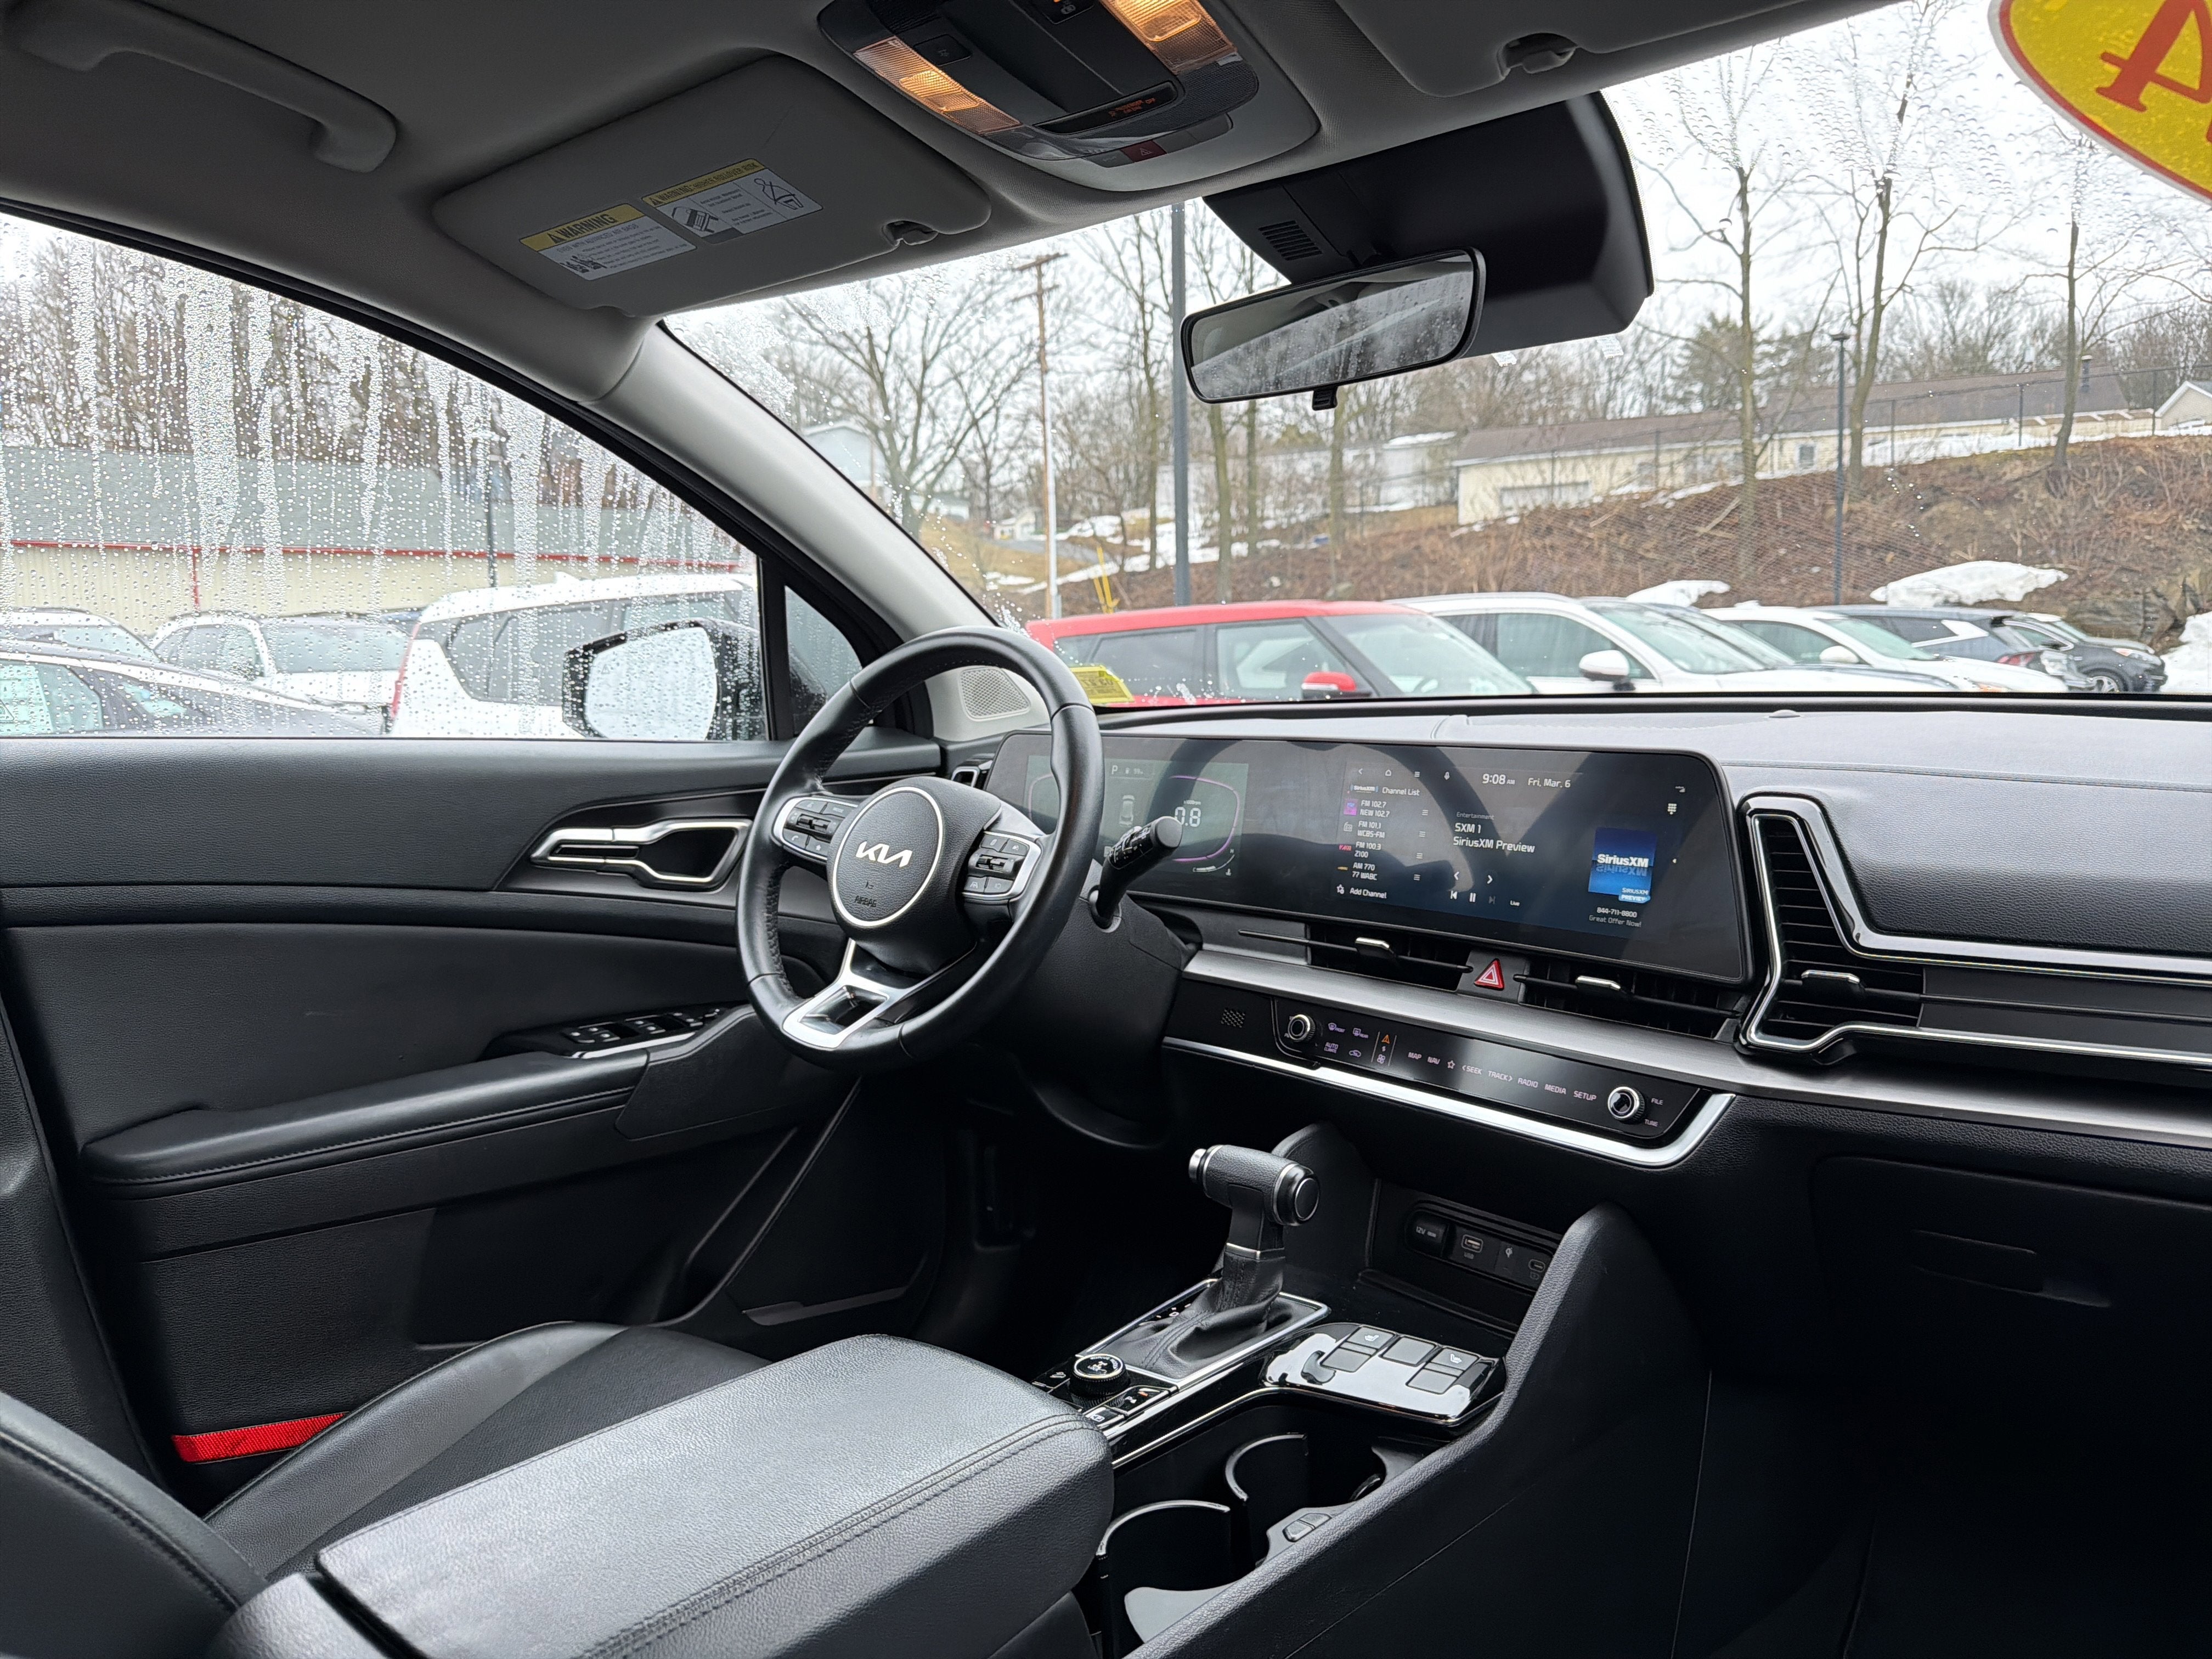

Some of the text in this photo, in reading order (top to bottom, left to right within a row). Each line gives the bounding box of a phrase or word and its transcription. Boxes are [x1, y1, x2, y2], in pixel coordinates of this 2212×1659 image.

[555, 213, 618, 239] WARNING
[1111, 765, 1118, 775] P
[1482, 774, 1506, 785] 9:08
[1543, 778, 1563, 788] Mar.
[1565, 780, 1571, 788] 6
[1382, 787, 1407, 795] Channel
[1175, 806, 1201, 827] 0.8
[1374, 810, 1390, 818] 102.7
[1456, 811, 1495, 820] Entertainment
[1454, 822, 1481, 834] SXM 1
[1453, 836, 1536, 853] SiriusXM Preview
[855, 841, 913, 868] KIA
[1597, 853, 1649, 868] SiriusXM
[1364, 863, 1375, 871] 770
[1360, 872, 1378, 881] WABC
[1349, 887, 1387, 899] Add Channel
[1596, 907, 1638, 918] 844-711-8800
[1607, 917, 1625, 925] Offer
[1626, 919, 1642, 928] Now!
[1408, 1052, 1422, 1060] MAP
[1427, 1056, 1441, 1065] NAV
[1466, 1065, 1483, 1075] SEEK
[1488, 1070, 1509, 1081] TRACK
[1517, 1077, 1539, 1088] RADIO
[1544, 1084, 1566, 1095] MEDIA
[1573, 1090, 1597, 1102] SETUP
[1644, 1119, 1658, 1127] TUNE
[1415, 1226, 1425, 1235] 12V
